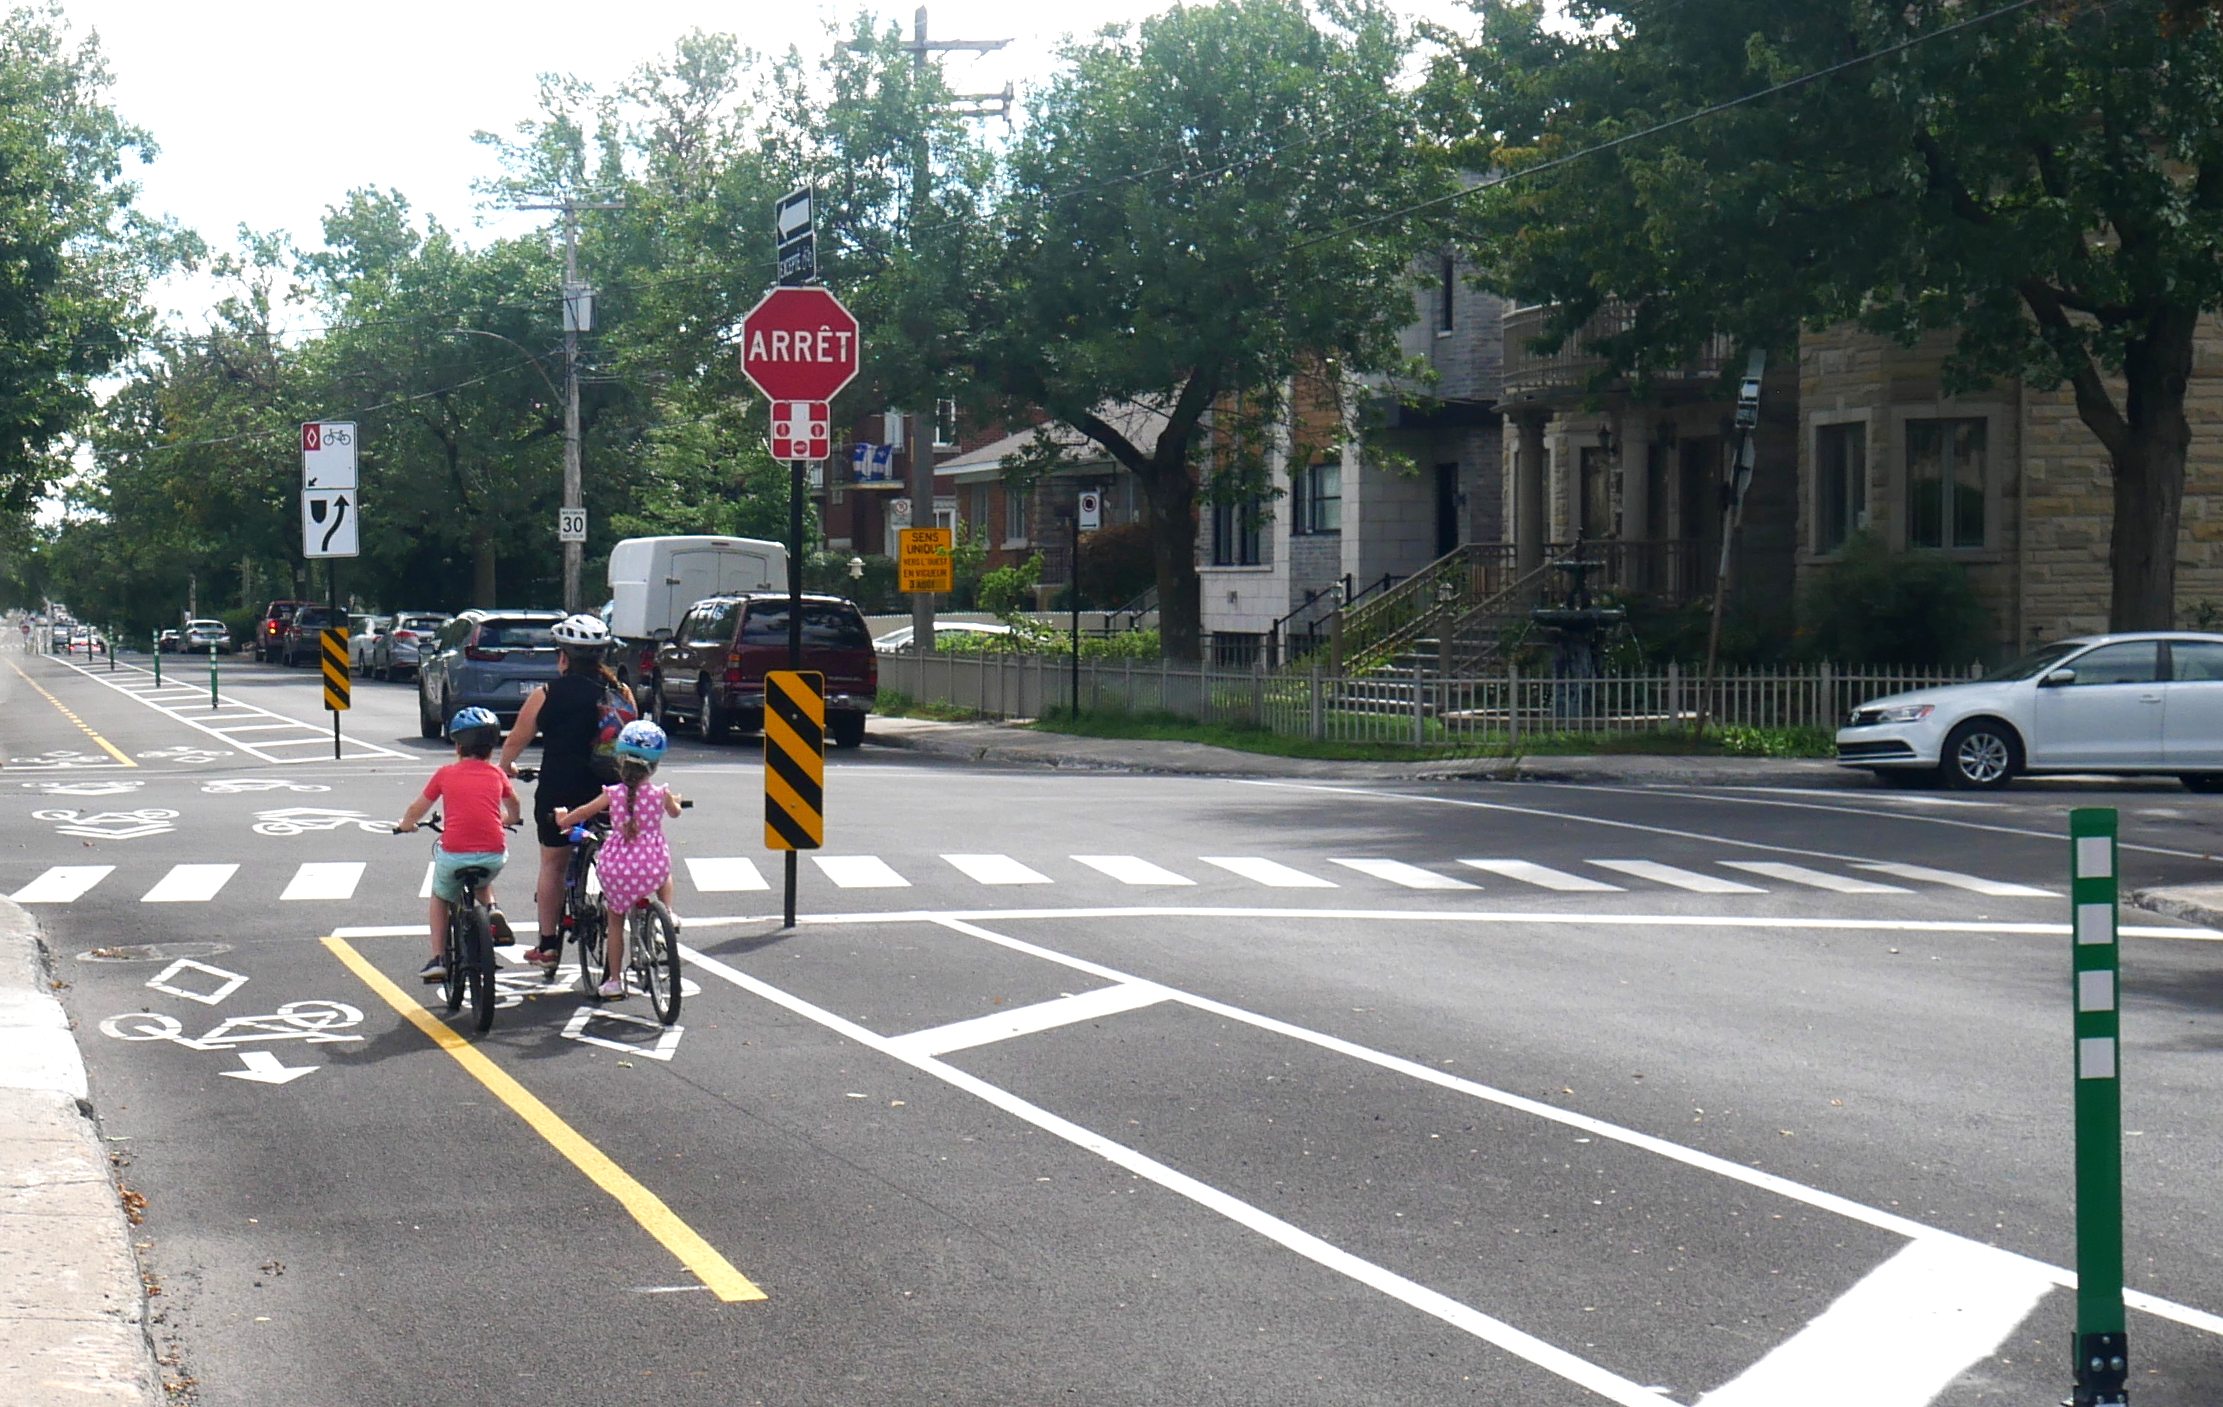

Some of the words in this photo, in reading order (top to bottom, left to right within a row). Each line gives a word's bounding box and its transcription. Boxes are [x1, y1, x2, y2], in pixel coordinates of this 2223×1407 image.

[748, 325, 851, 362] ARRÊT
[563, 516, 583, 533] 30
[912, 532, 939, 542] SENS
[907, 543, 944, 554] UNIQU
[903, 569, 914, 578] EN
[915, 569, 947, 578] VIGUEUR
